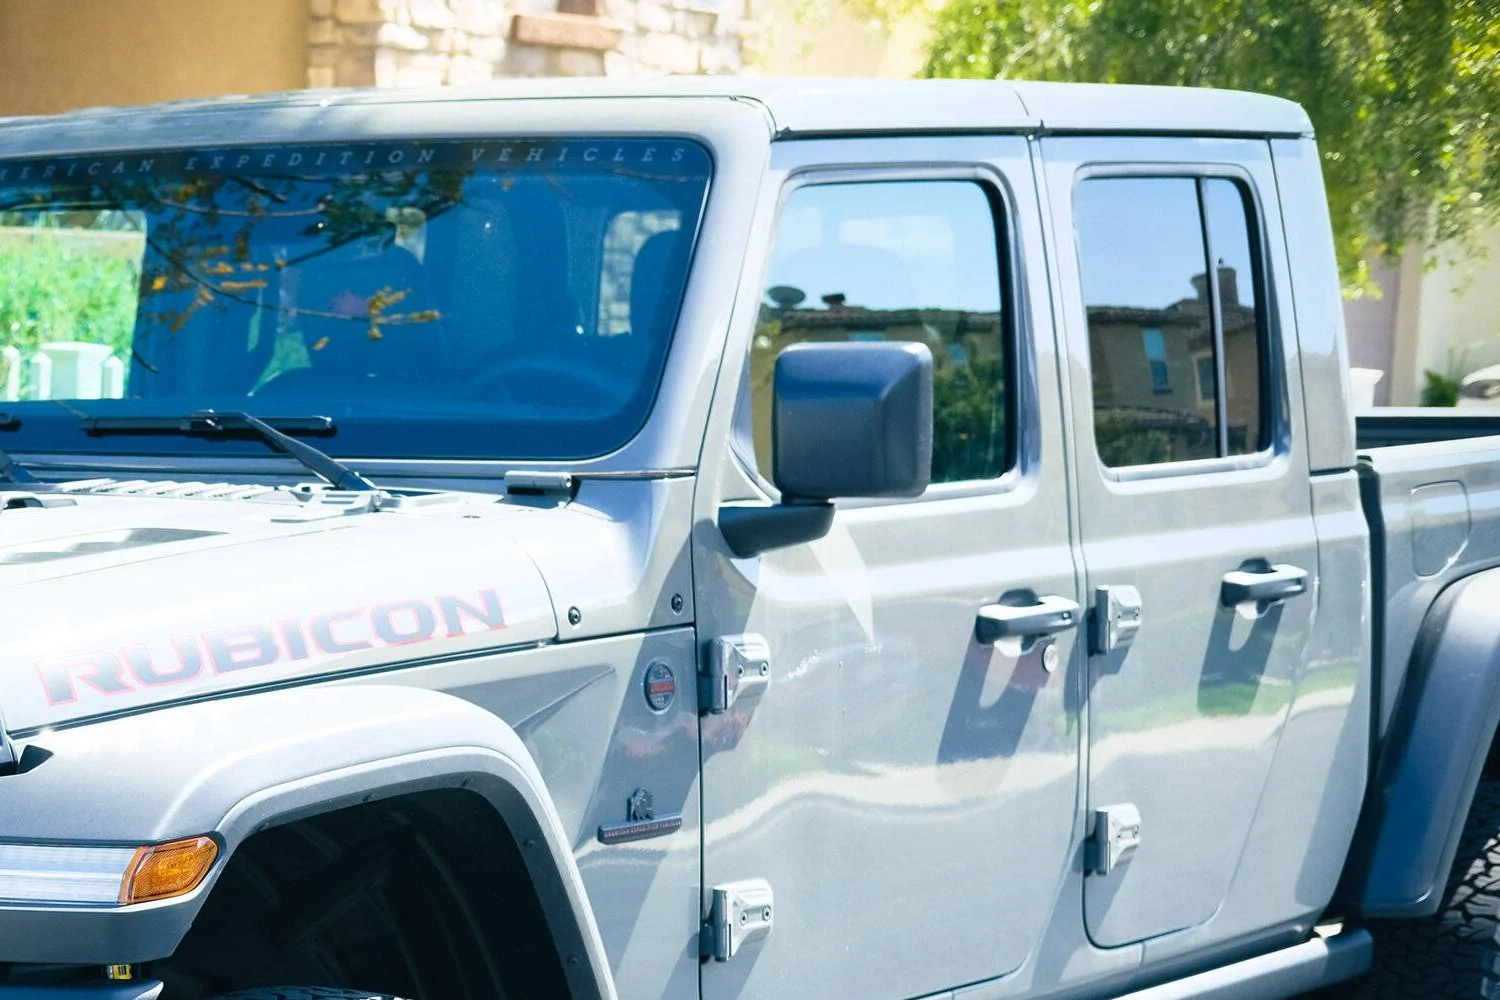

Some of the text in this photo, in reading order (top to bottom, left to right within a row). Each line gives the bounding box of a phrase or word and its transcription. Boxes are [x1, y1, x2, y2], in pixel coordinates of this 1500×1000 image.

[184, 150, 436, 171] EXPEDITION
[470, 147, 686, 163] VEHICLES
[34, 589, 509, 706] RUBICON
